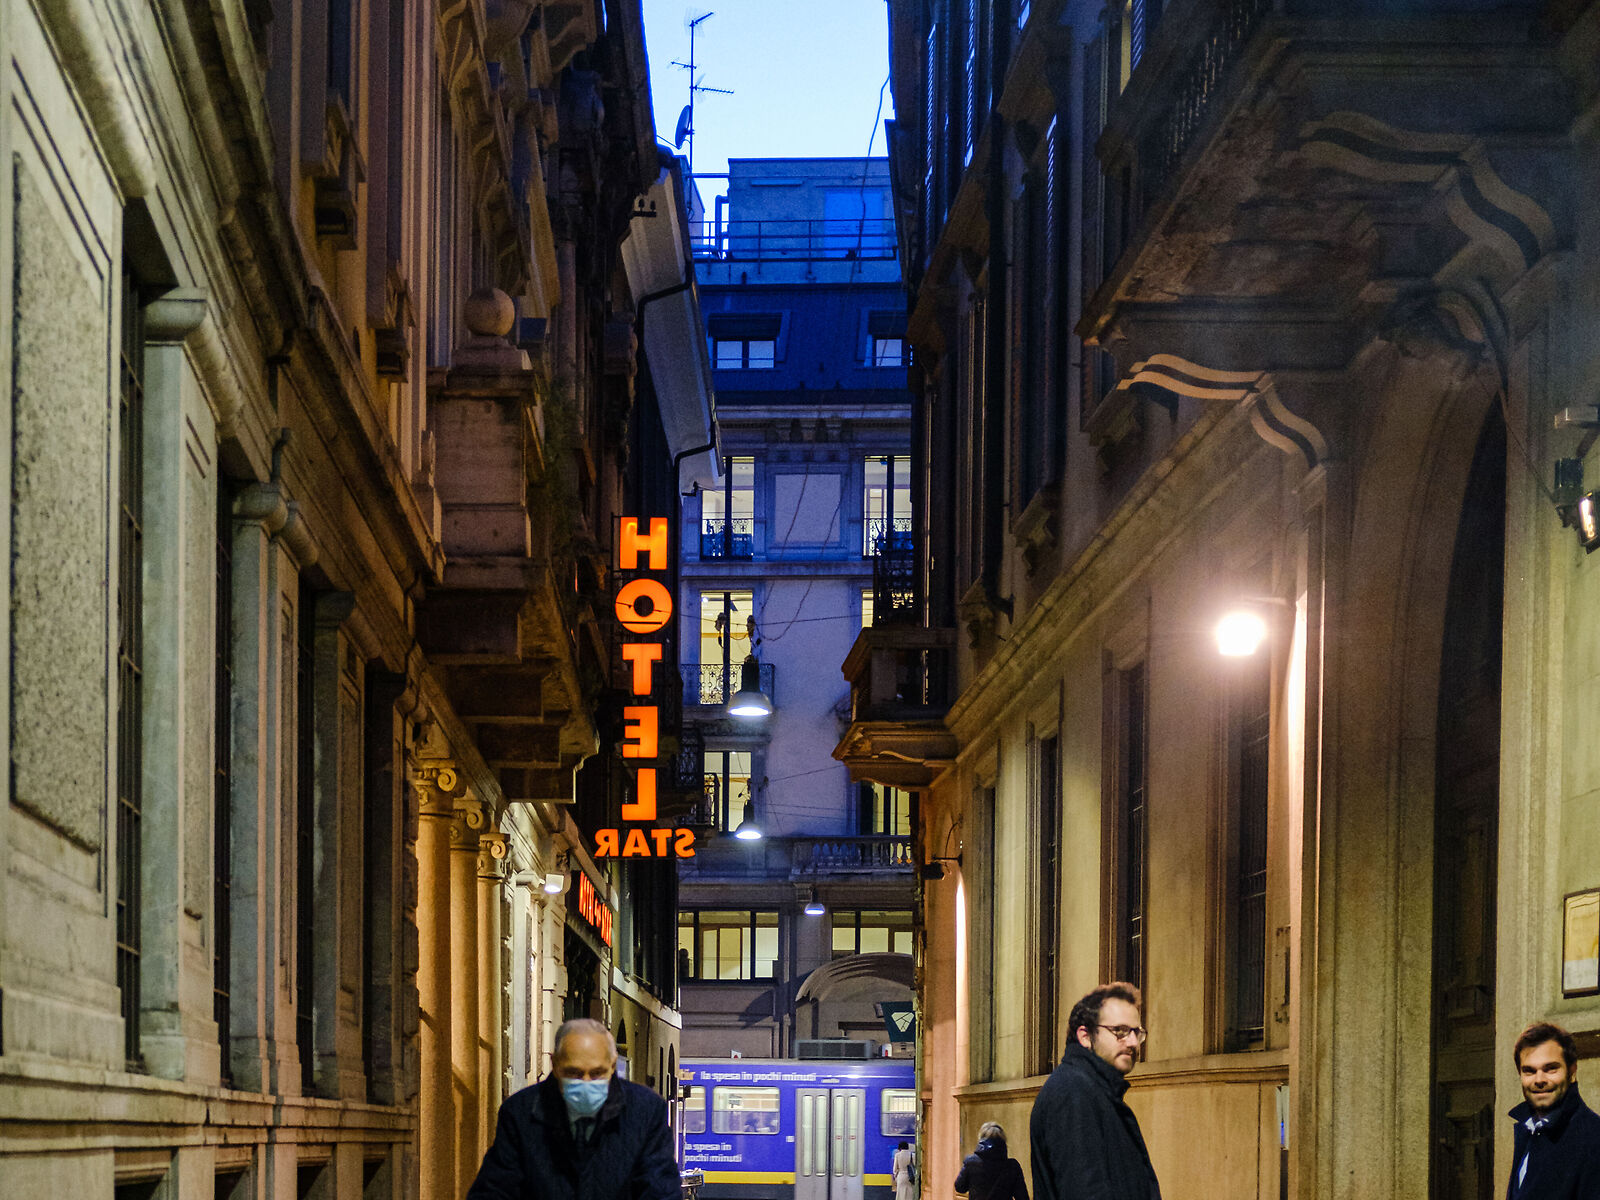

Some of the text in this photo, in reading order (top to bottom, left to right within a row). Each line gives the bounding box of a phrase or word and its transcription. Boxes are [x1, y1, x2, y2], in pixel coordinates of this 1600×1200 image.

[711, 1073, 741, 1082] spesa
[741, 1071, 753, 1080] in
[753, 1072, 782, 1082] pochi
[782, 1072, 817, 1081] minuti
[692, 1144, 720, 1152] spesa
[721, 1142, 732, 1151] in
[710, 1153, 742, 1162] minuti
